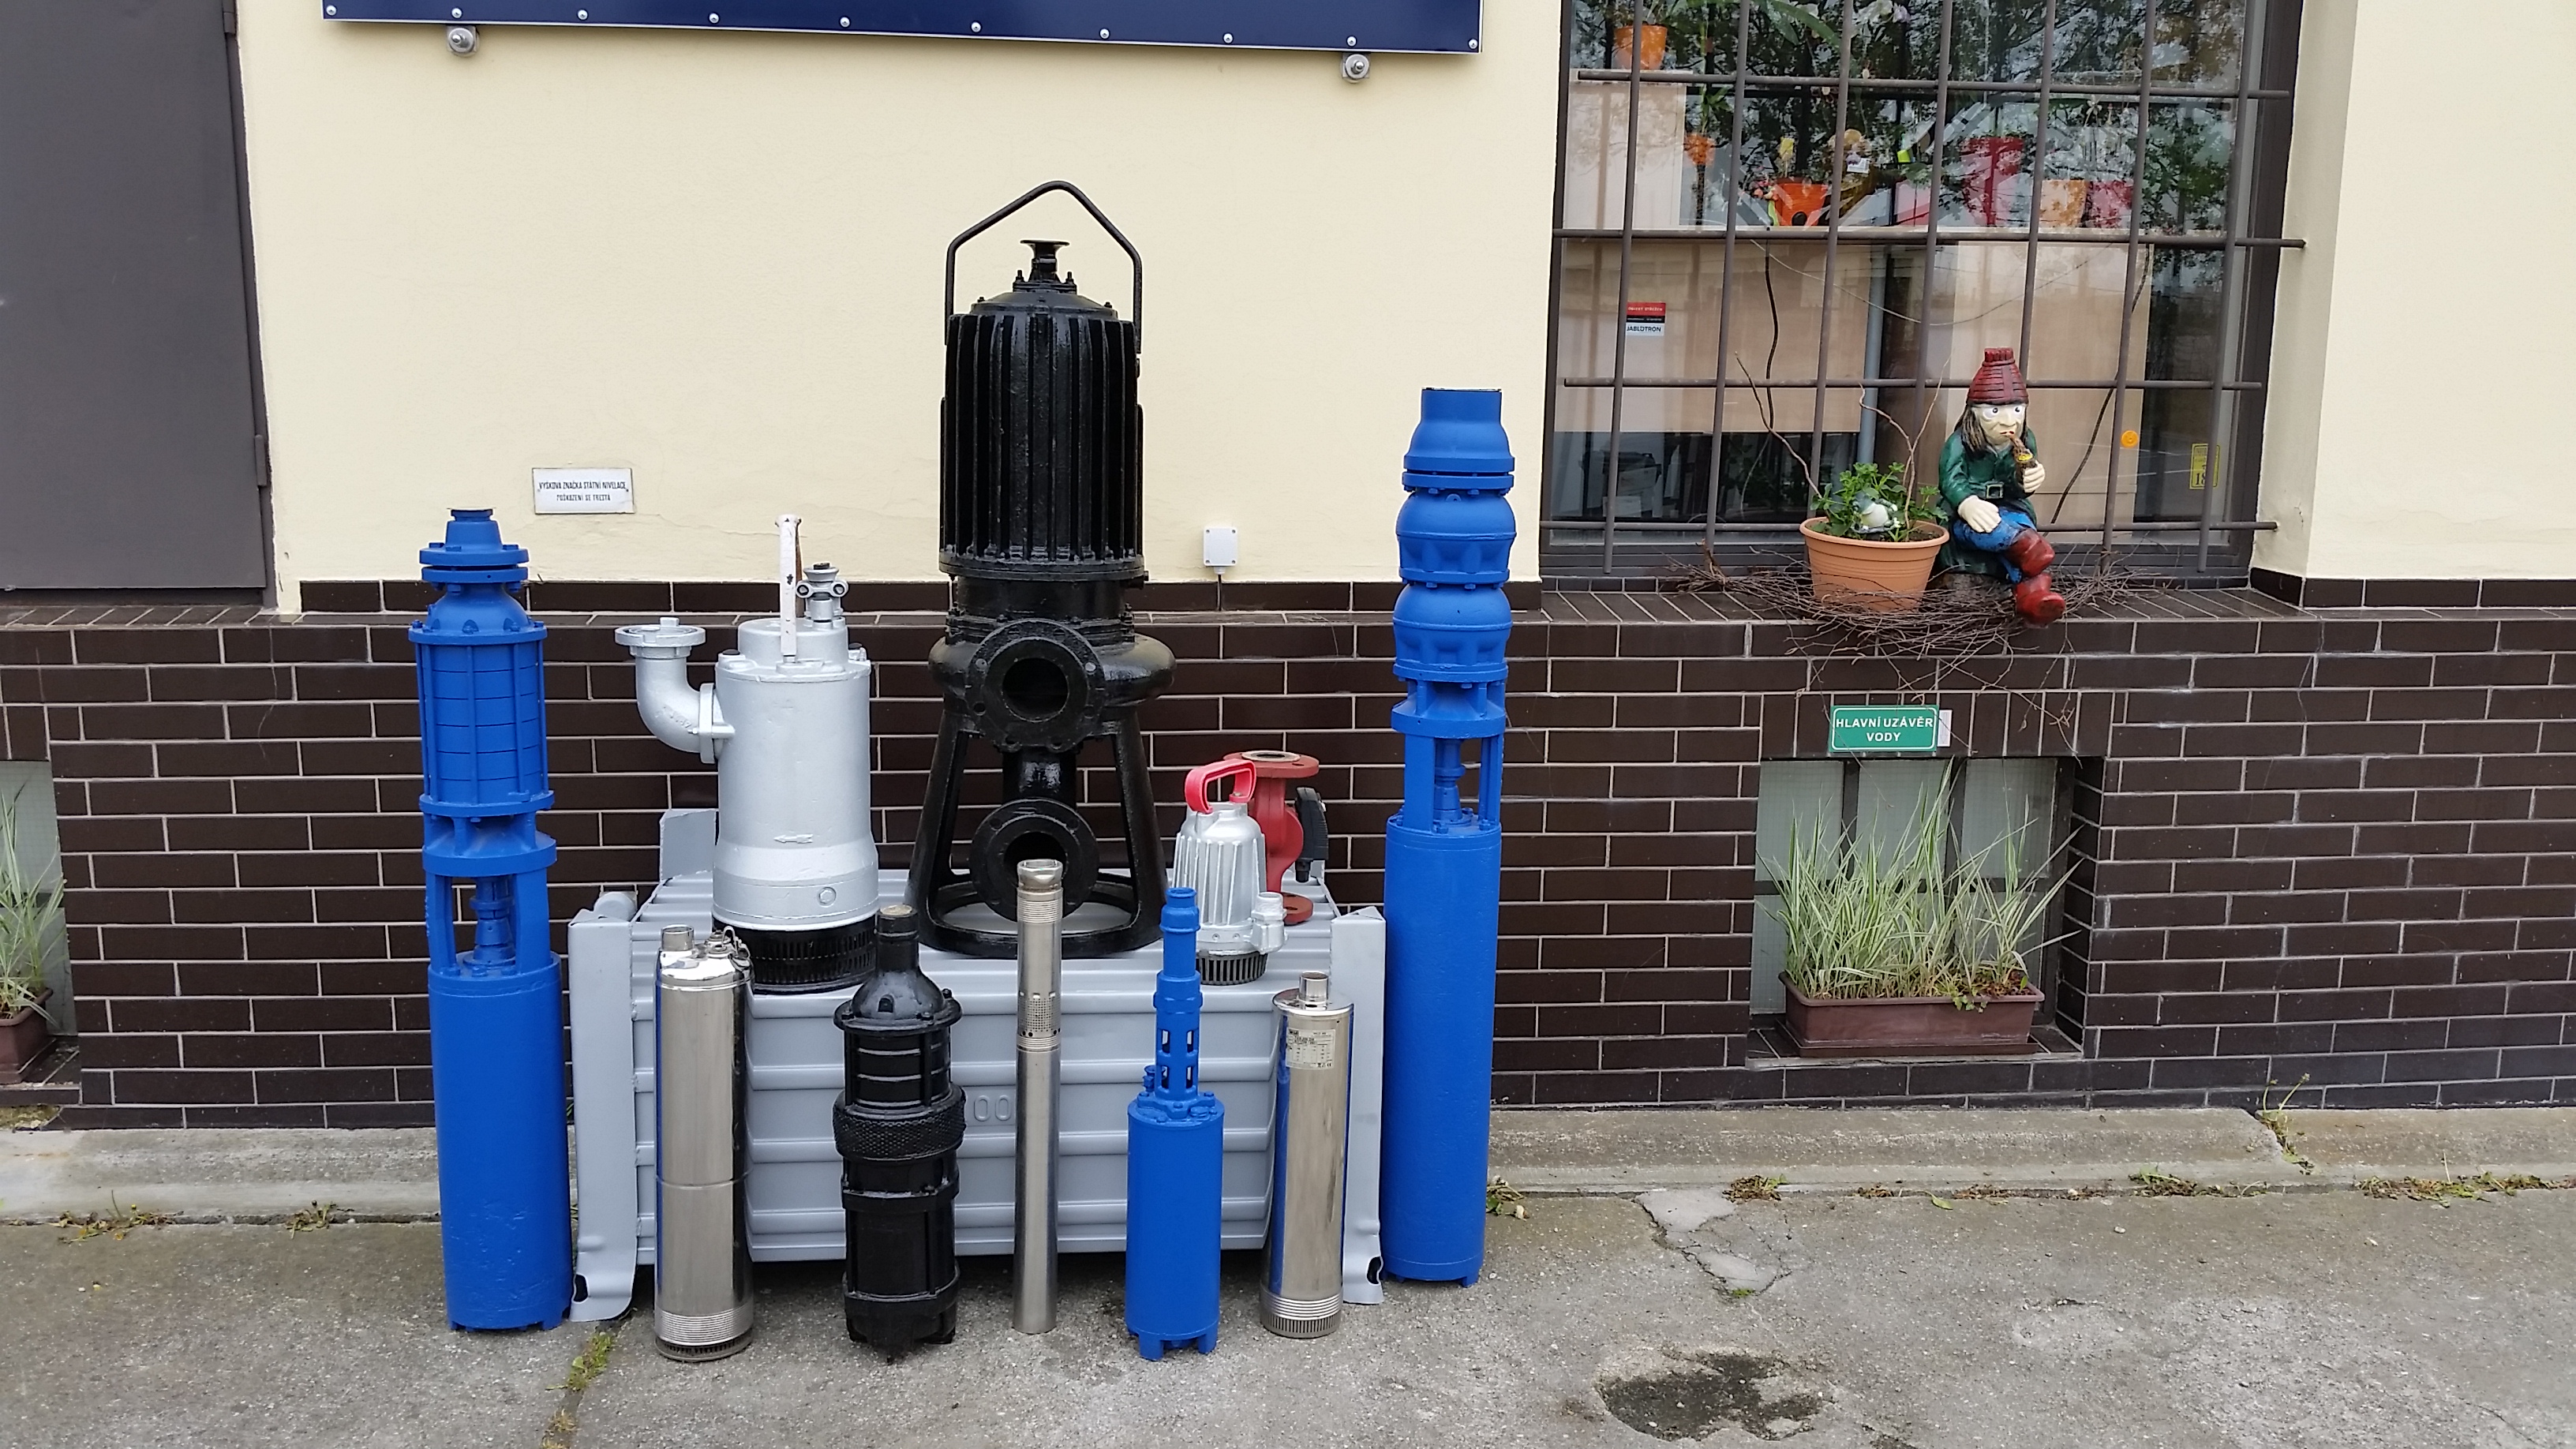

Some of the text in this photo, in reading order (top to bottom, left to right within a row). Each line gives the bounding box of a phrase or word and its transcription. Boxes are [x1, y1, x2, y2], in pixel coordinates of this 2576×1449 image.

[1836, 717, 1934, 728] HLAVNÍ UZÁVĚR
[1866, 732, 1901, 742] VODY
